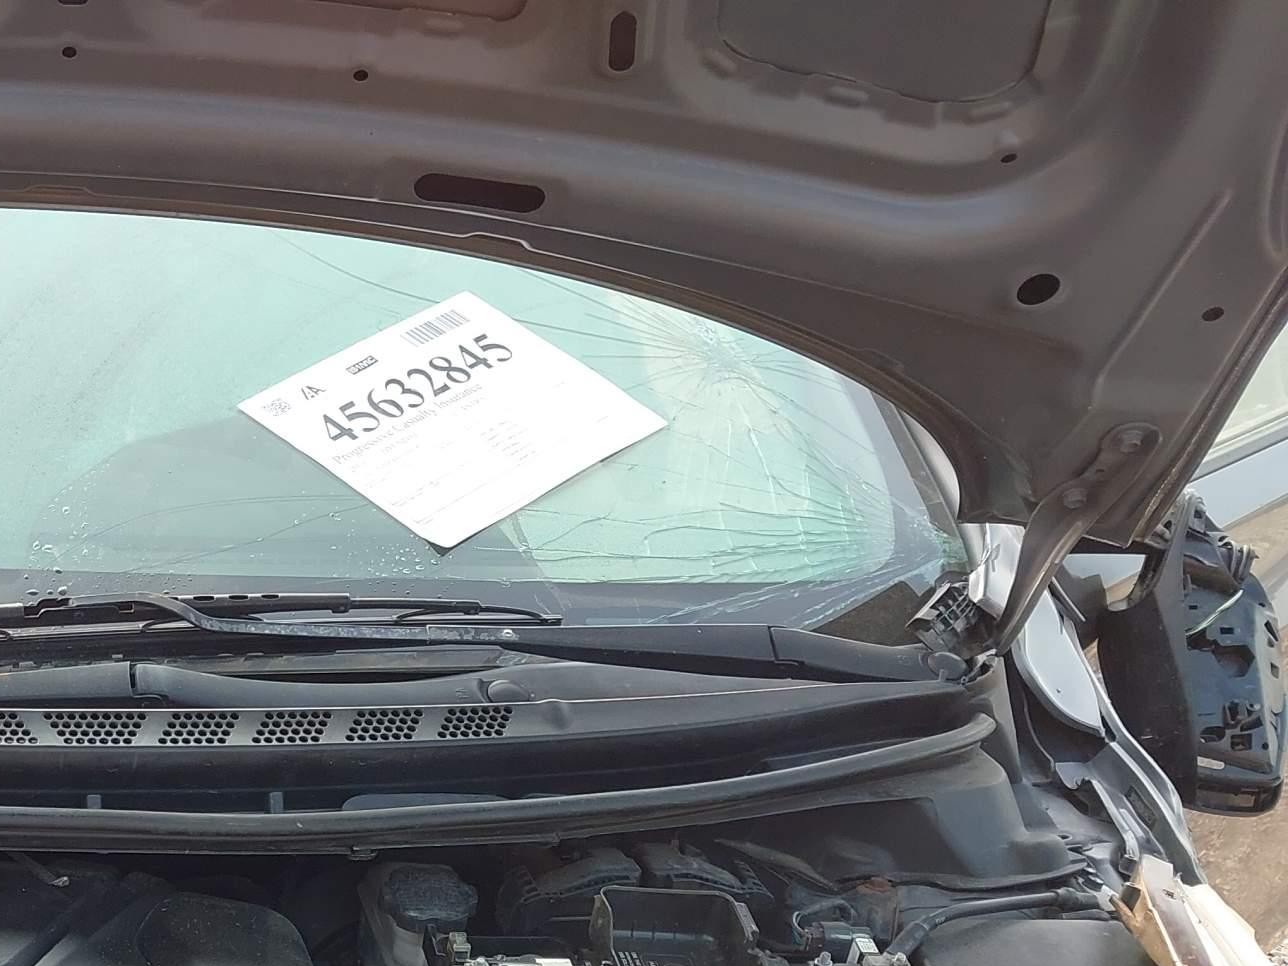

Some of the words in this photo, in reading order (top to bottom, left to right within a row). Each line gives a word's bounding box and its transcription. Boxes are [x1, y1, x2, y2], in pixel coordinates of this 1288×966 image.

[323, 333, 513, 442] 45632845
[332, 429, 393, 465] Progressive
[392, 407, 438, 430] Casualty
[433, 383, 483, 409] Insurance
